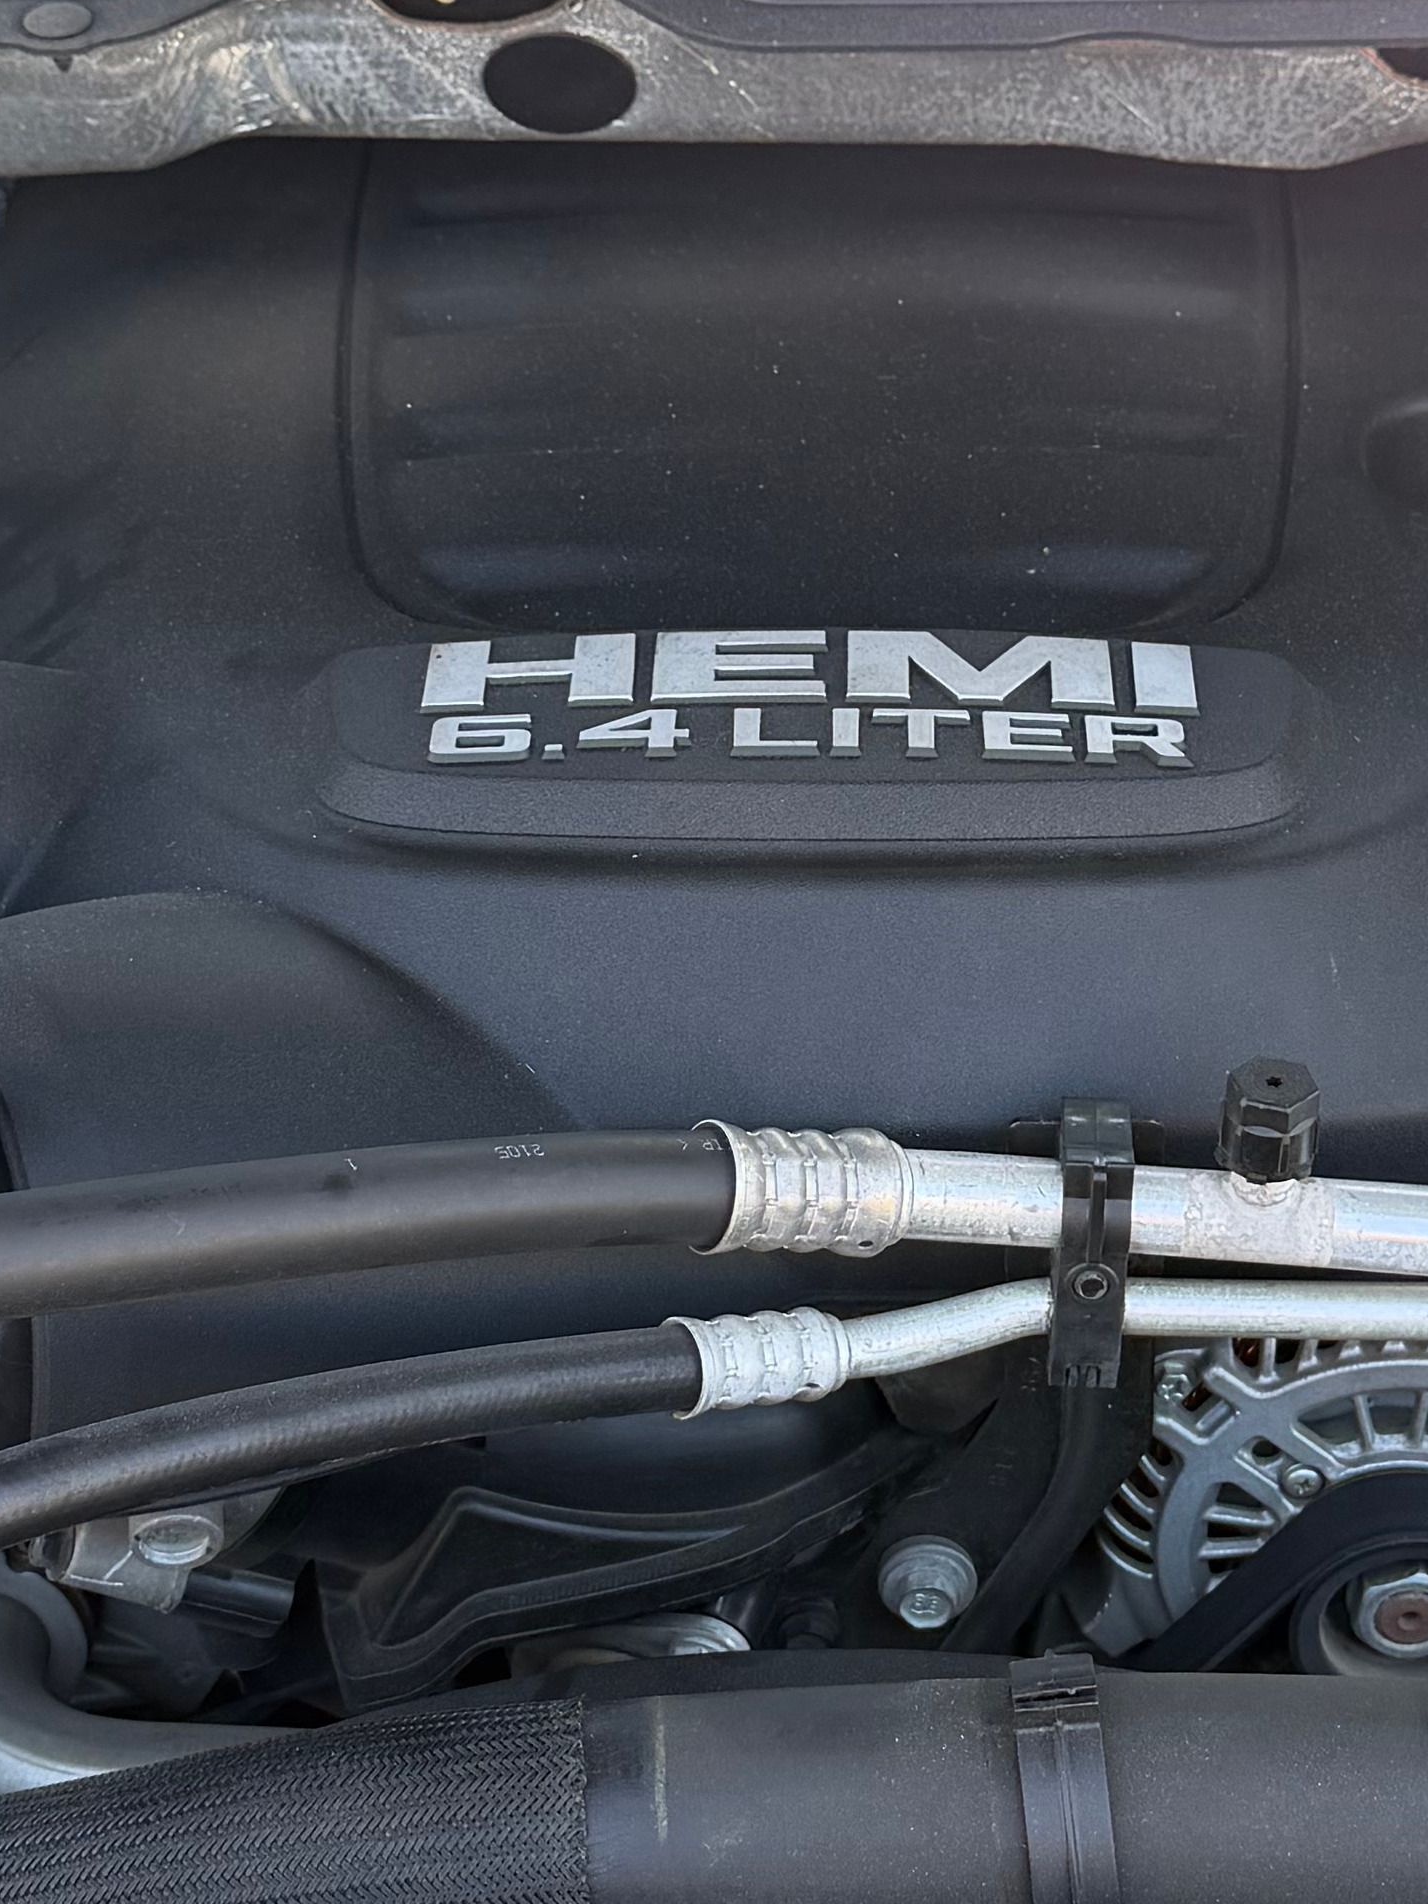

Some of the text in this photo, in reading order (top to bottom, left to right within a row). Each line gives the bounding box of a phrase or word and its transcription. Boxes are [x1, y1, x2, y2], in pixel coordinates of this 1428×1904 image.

[419, 629, 1200, 717] HEMI
[426, 706, 1194, 767] 6.4 LITER
